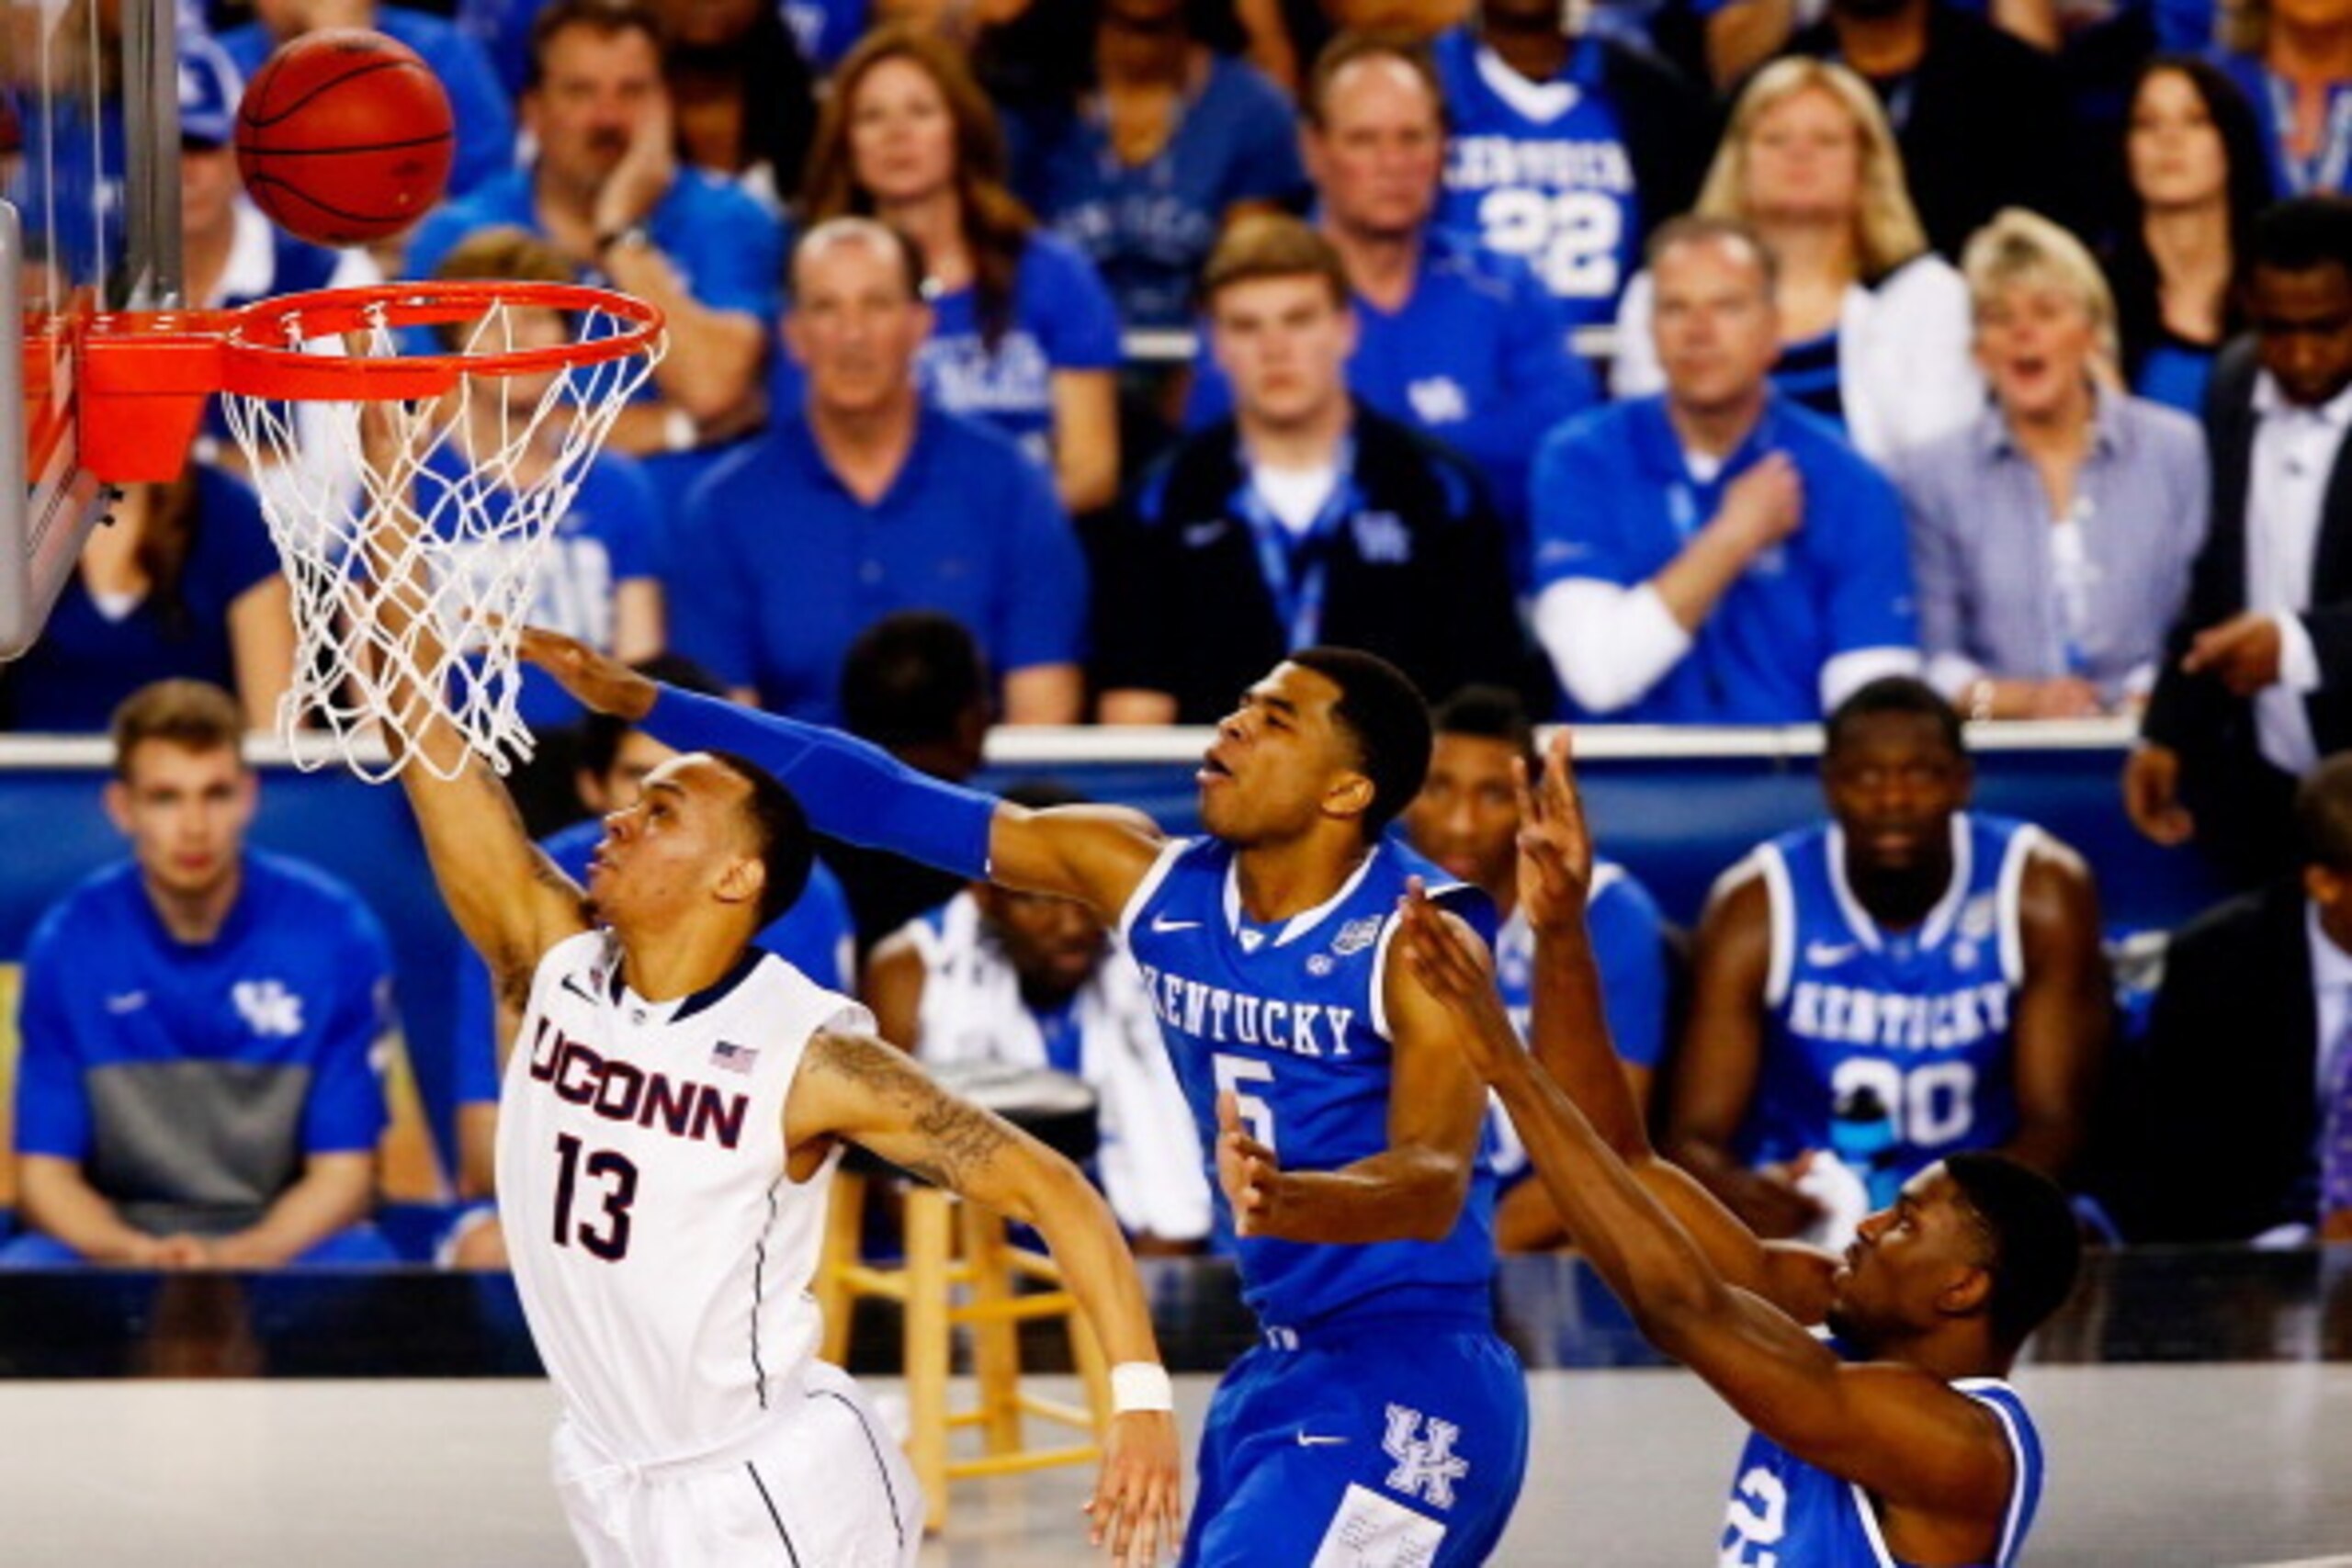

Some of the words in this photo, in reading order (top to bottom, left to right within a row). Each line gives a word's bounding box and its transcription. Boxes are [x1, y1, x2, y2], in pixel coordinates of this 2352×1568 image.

[1790, 980, 2010, 1050] KENTUCKY
[529, 1015, 750, 1150] UCONN
[552, 1131, 639, 1264] 13
